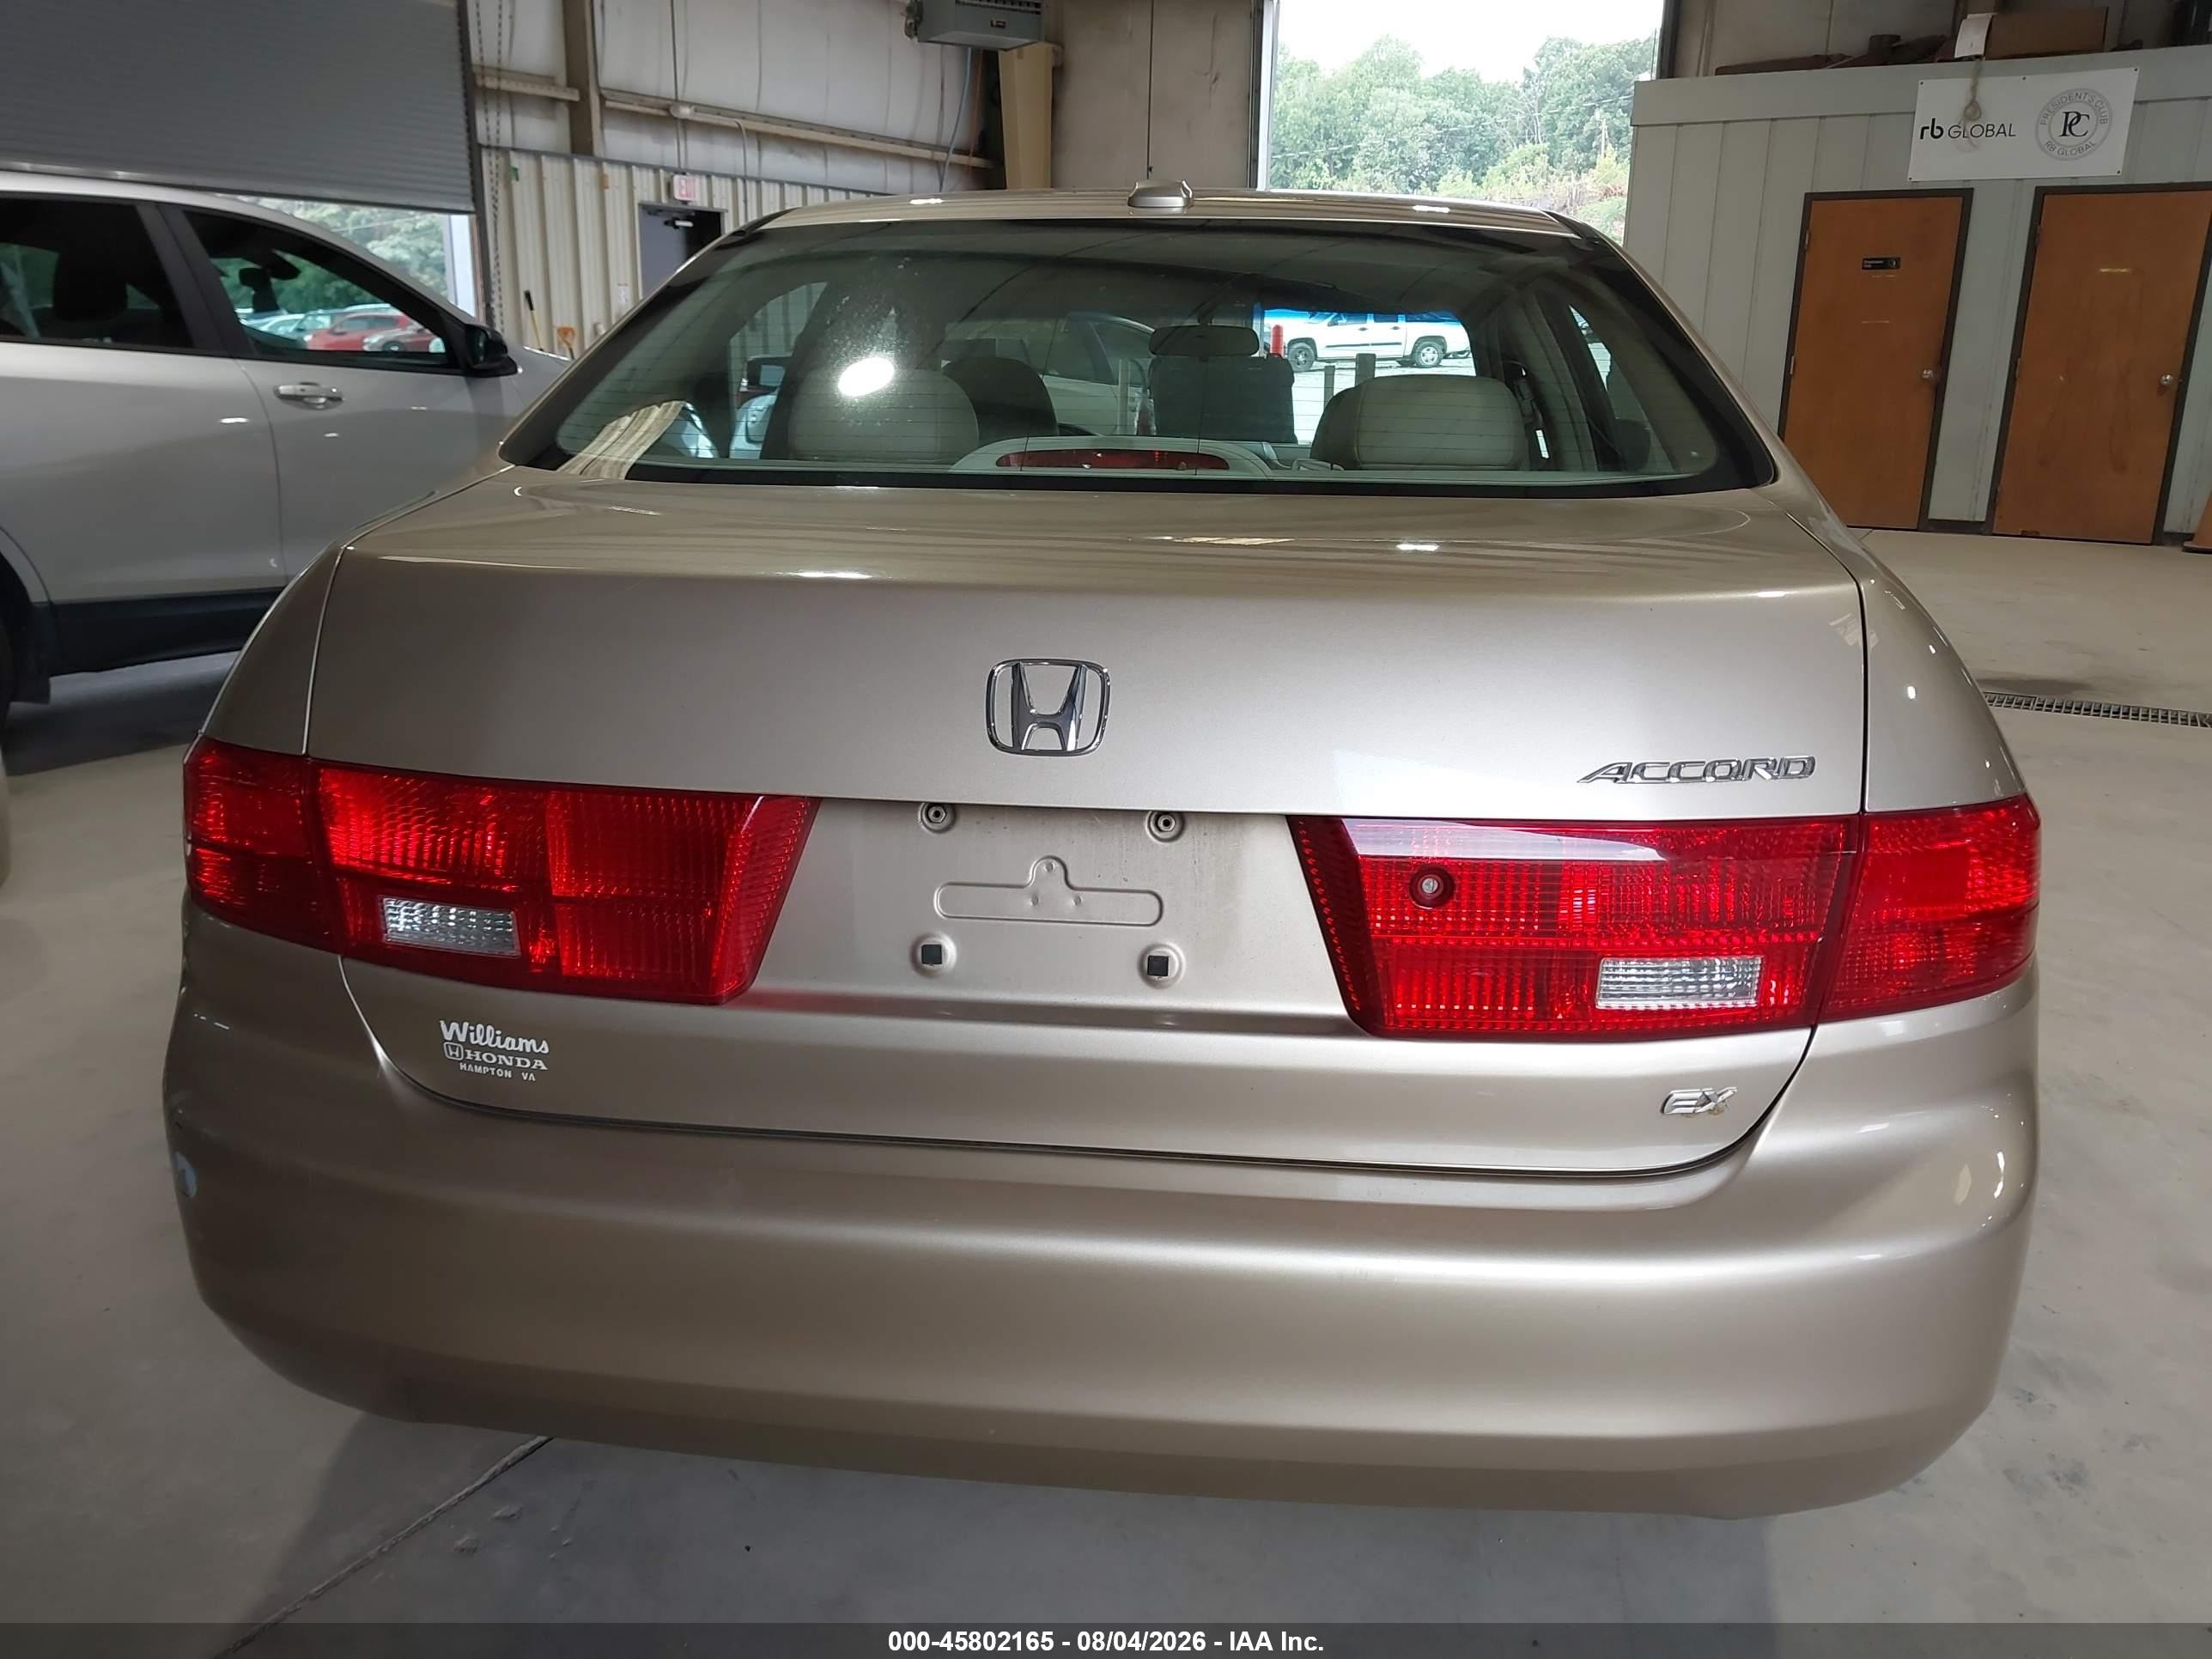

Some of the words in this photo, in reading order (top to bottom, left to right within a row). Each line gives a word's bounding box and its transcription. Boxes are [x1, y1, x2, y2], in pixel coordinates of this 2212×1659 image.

[2094, 100, 2109, 125] CLUB
[1919, 117, 1944, 139] rb
[1948, 123, 2016, 139] GLOBAL
[2044, 140, 2057, 153] RB
[2057, 140, 2097, 156] GLOBAL
[1577, 756, 1816, 784] ACCORD
[439, 1019, 550, 1054] Williams
[459, 1061, 513, 1079] HAMPTON
[521, 1072, 537, 1082] VA
[465, 1048, 549, 1071] HONDA
[1660, 1086, 1738, 1115] EX
